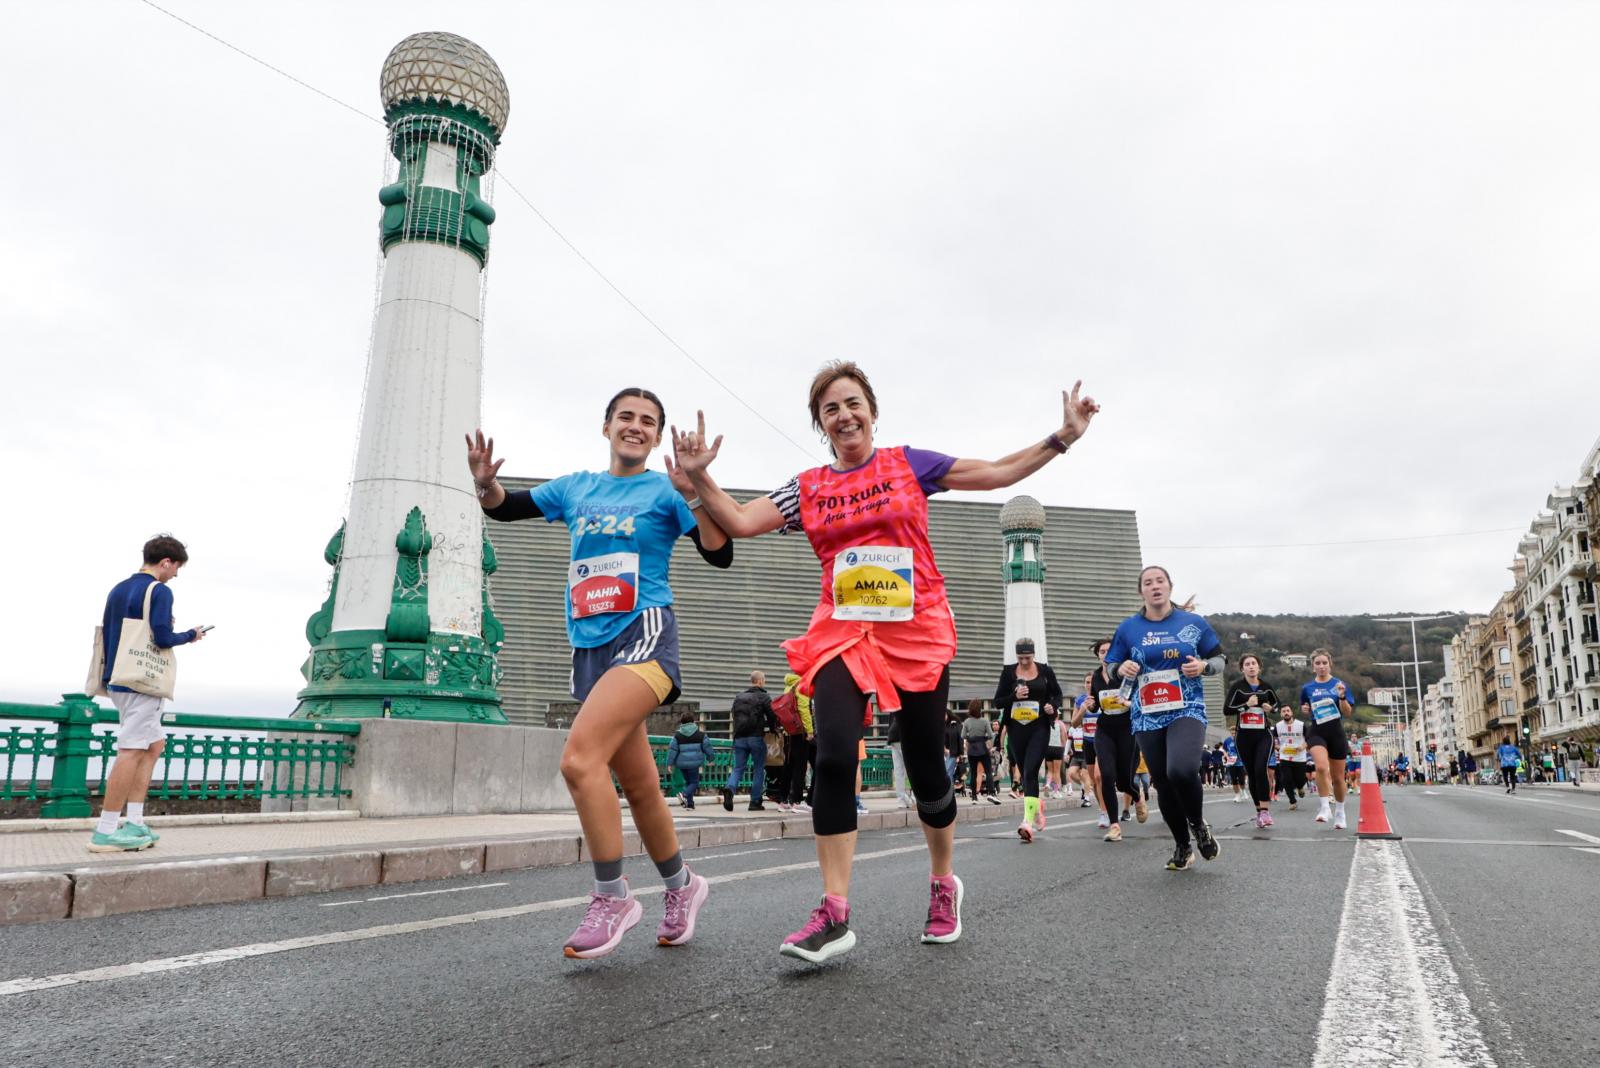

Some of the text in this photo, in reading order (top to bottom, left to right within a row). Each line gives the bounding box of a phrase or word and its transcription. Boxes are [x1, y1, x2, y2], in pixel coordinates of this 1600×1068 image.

[817, 481, 894, 513] POTXUAK
[854, 580, 899, 591] AMAIA
[586, 585, 622, 601] NAHIA
[860, 595, 888, 605] 10762
